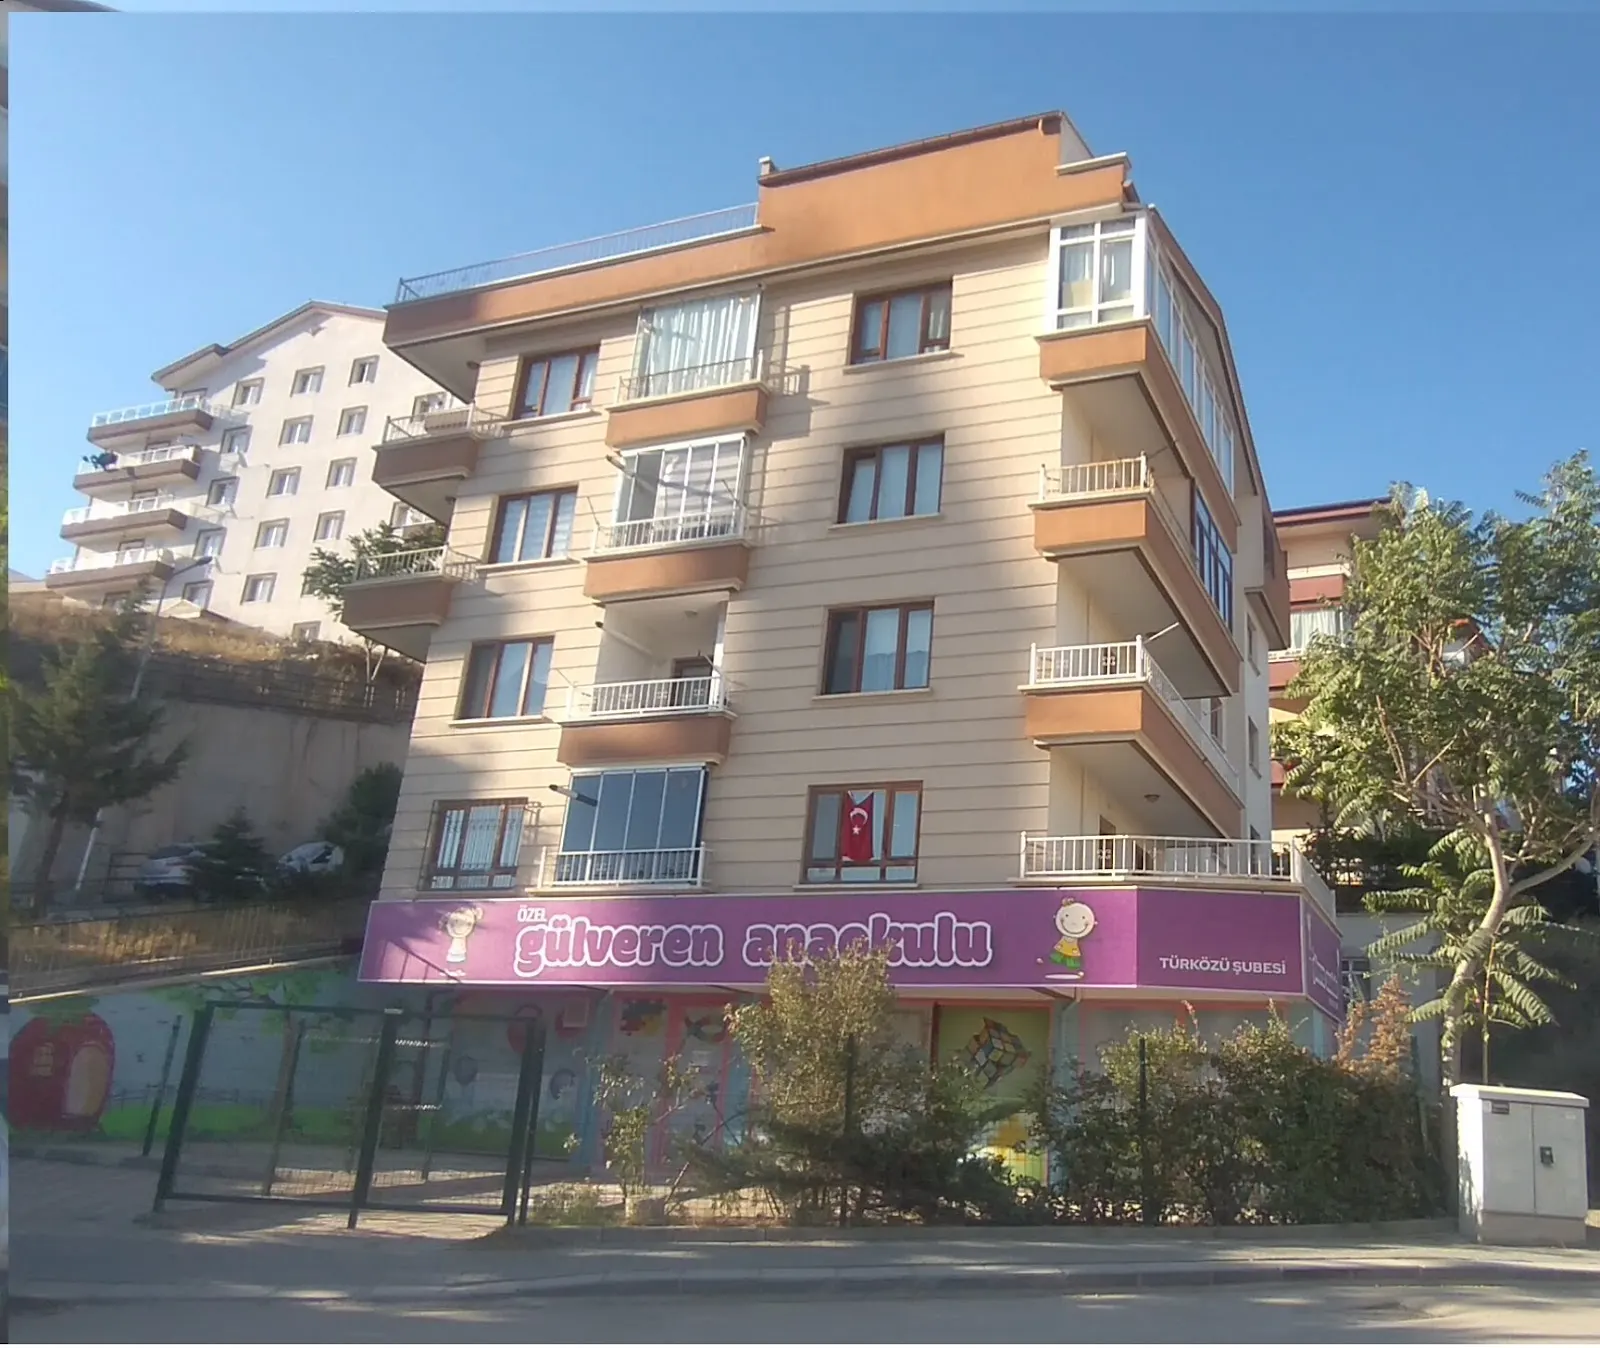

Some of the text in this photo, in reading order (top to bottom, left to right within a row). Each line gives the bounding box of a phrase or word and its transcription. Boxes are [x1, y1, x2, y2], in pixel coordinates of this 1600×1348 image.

[517, 904, 547, 922] ÖZEL
[513, 914, 724, 978] gülveren
[1159, 954, 1287, 975] TÜRKÖZÜ ŞUBESİ
